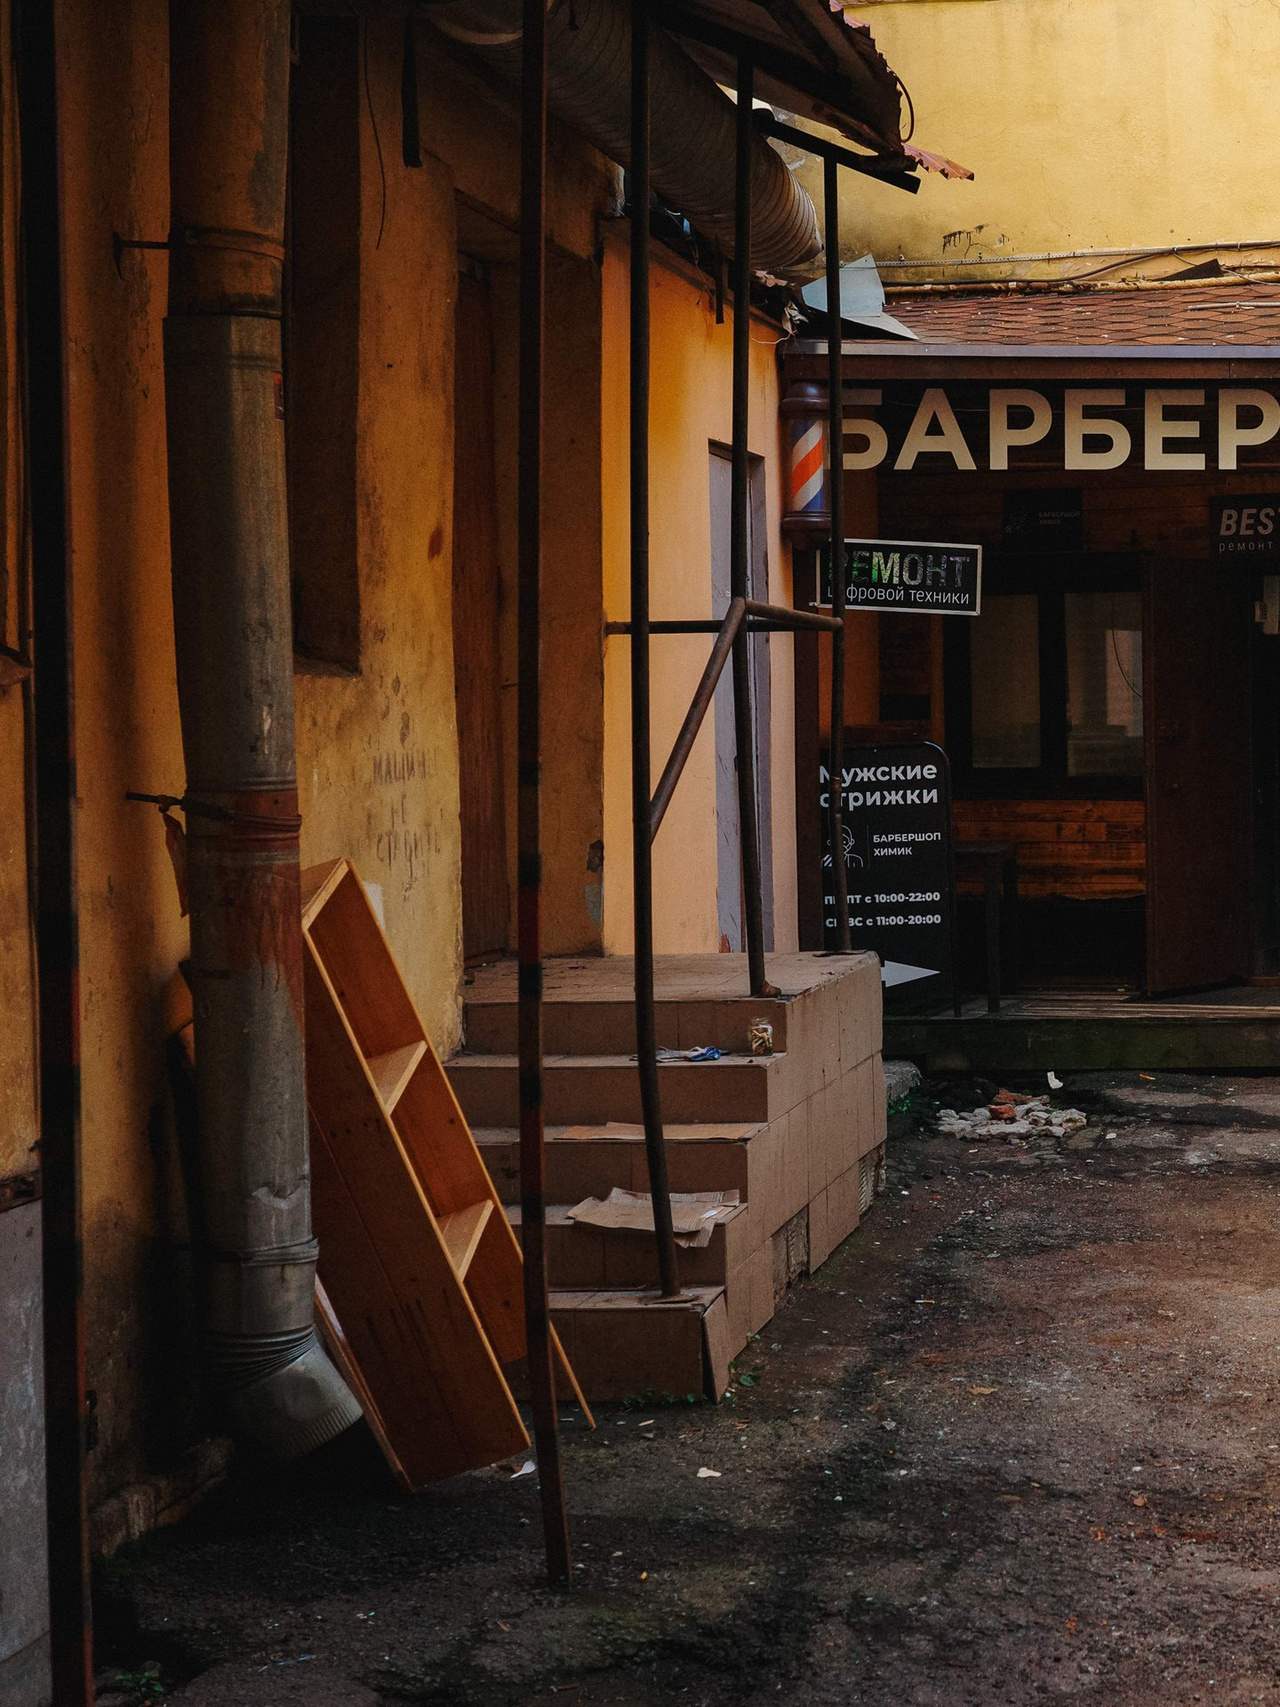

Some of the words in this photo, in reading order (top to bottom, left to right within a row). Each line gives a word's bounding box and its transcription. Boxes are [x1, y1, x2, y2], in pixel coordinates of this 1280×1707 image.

[1218, 540, 1273, 554] ремонт
[827, 584, 904, 602] фровой
[909, 588, 970, 605] техники
[873, 832, 942, 843] БАРБЕРШОП
[873, 846, 913, 856] ХИМИК
[874, 891, 941, 903] 10:00-22:00
[875, 914, 942, 926] 11:00-20:00
